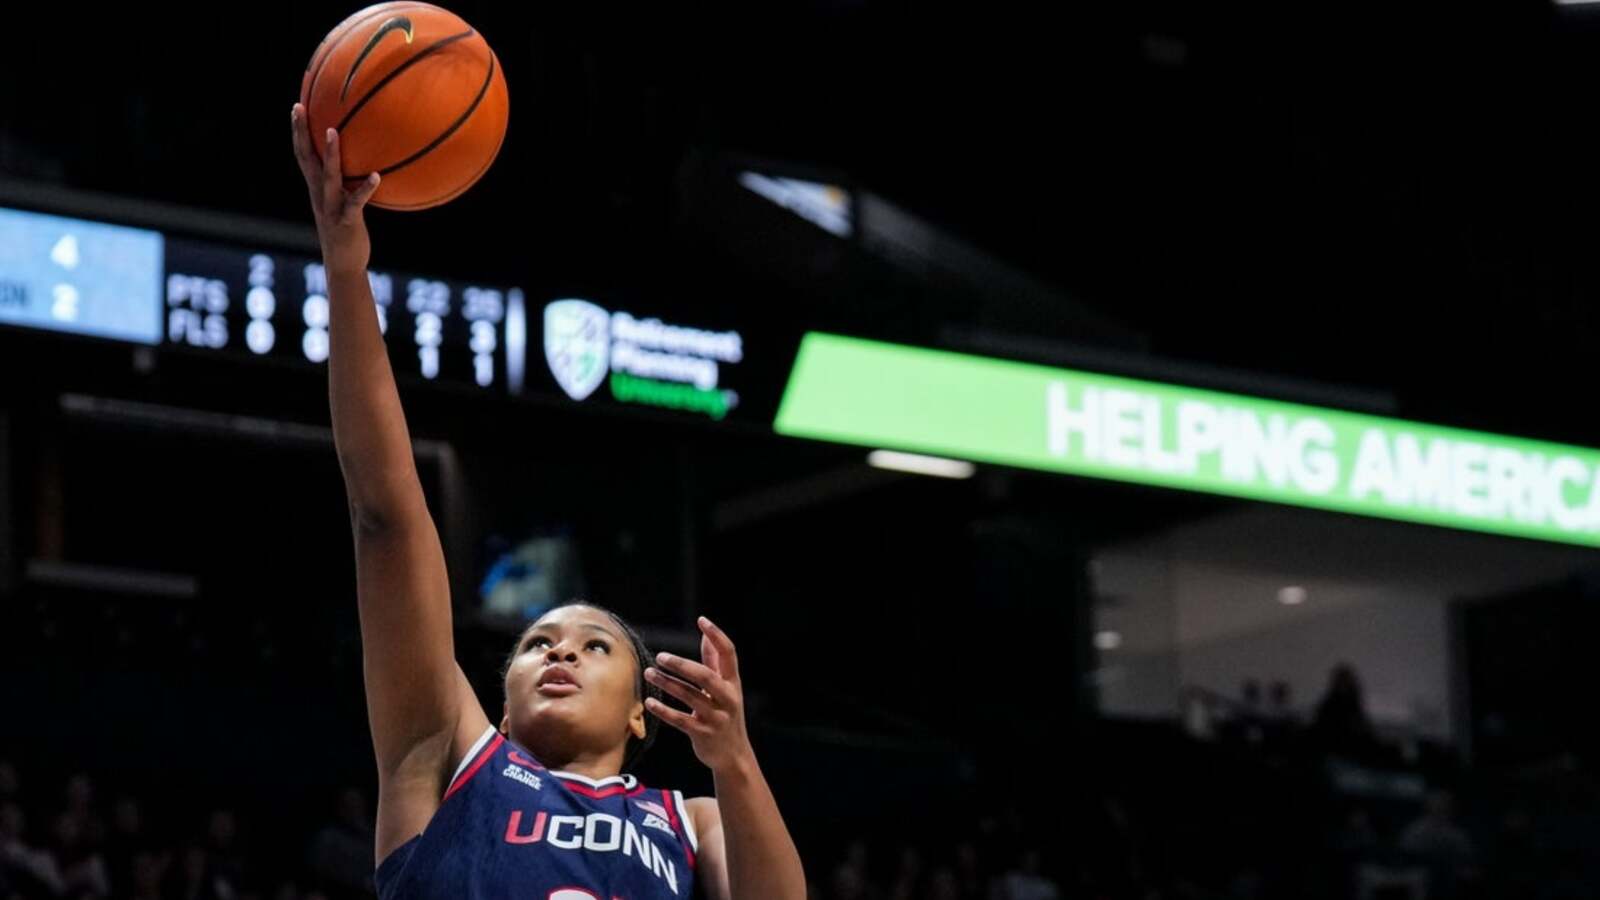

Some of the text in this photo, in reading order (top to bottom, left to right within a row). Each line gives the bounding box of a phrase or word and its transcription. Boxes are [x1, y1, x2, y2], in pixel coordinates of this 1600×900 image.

[51, 234, 79, 270] 4
[51, 283, 79, 321] 2
[168, 274, 229, 314] PTS
[246, 286, 275, 320] 0
[415, 312, 442, 346] 2
[469, 320, 497, 353] 3
[407, 279, 450, 316] 22
[169, 308, 229, 350] FLS
[246, 319, 275, 354] 0
[418, 345, 439, 379] 1
[473, 353, 494, 387] 1
[1047, 381, 1600, 533] HELPING AMERIC
[502, 767, 543, 791] CHANGE
[504, 810, 680, 896] UCONN
